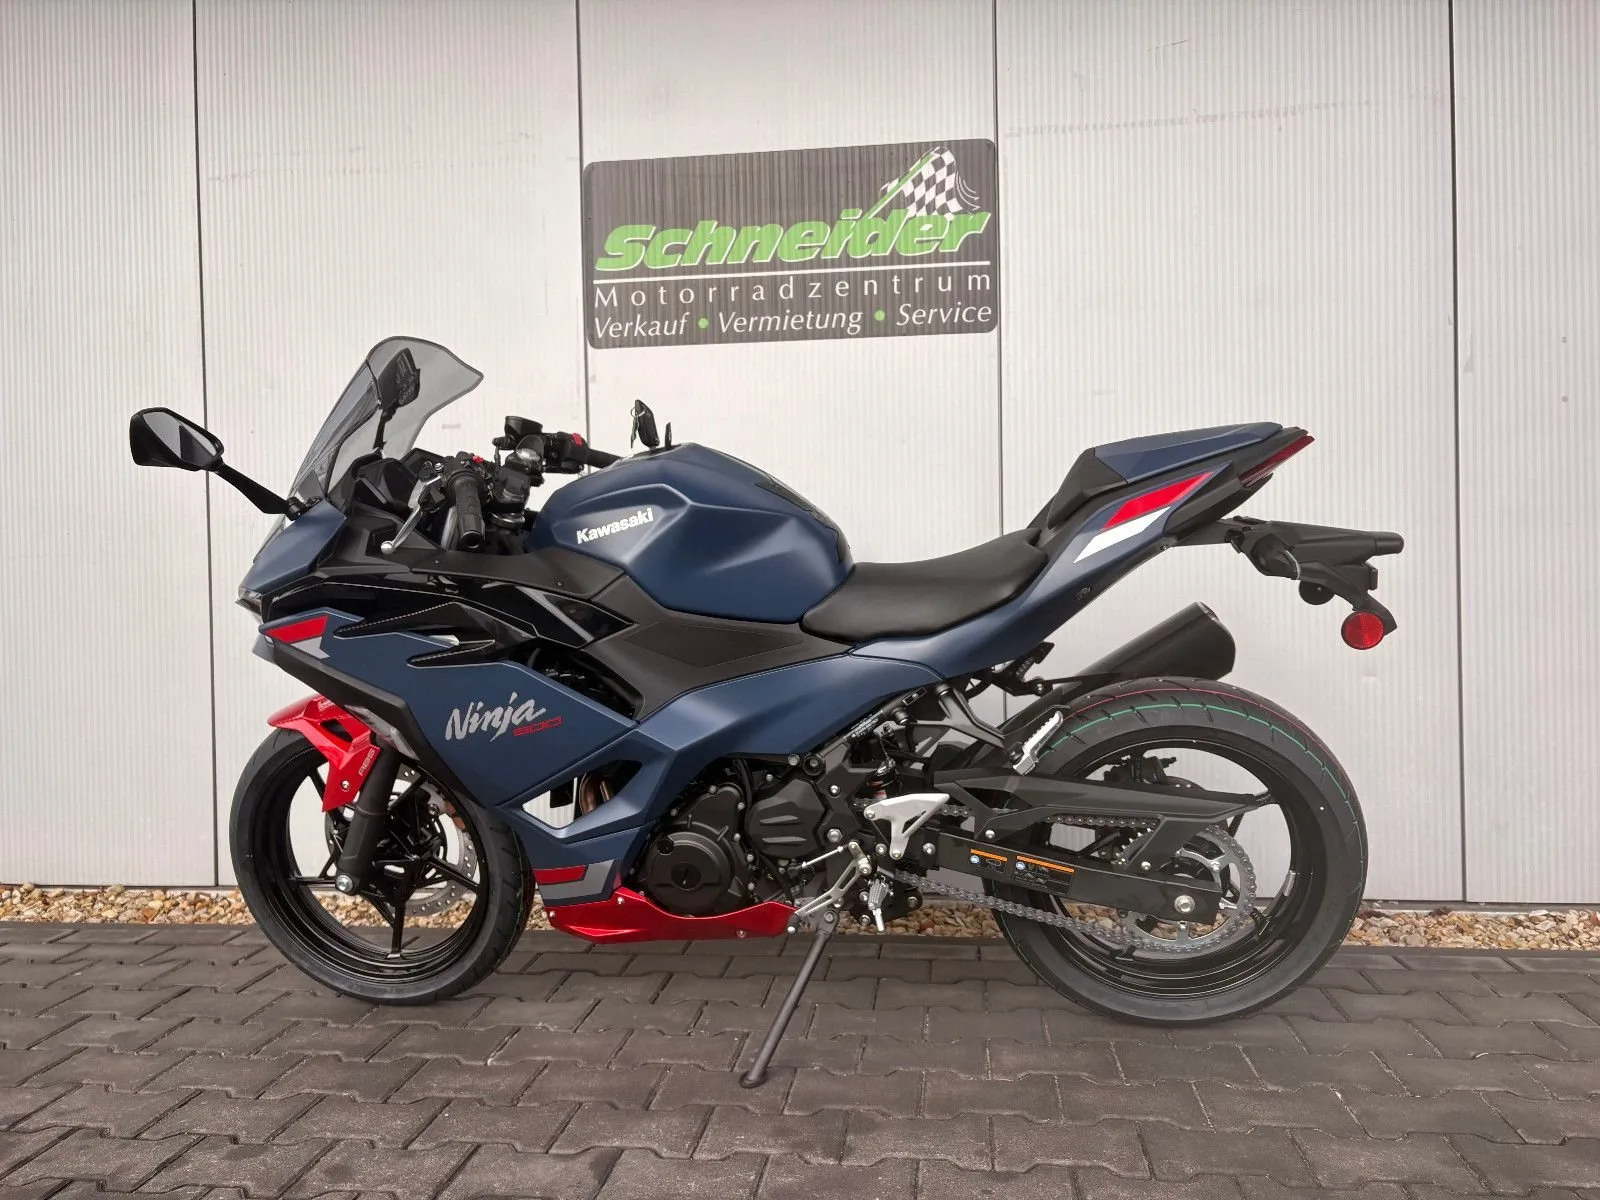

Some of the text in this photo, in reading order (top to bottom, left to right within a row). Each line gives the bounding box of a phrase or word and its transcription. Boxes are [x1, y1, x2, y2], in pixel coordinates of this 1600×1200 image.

[595, 208, 991, 271] Schneider
[594, 273, 991, 308] Motorradzentrum
[594, 302, 992, 339] Verkauf Vermietung Service
[576, 507, 654, 544] Kawasaki
[445, 691, 562, 742] Ninja 500
